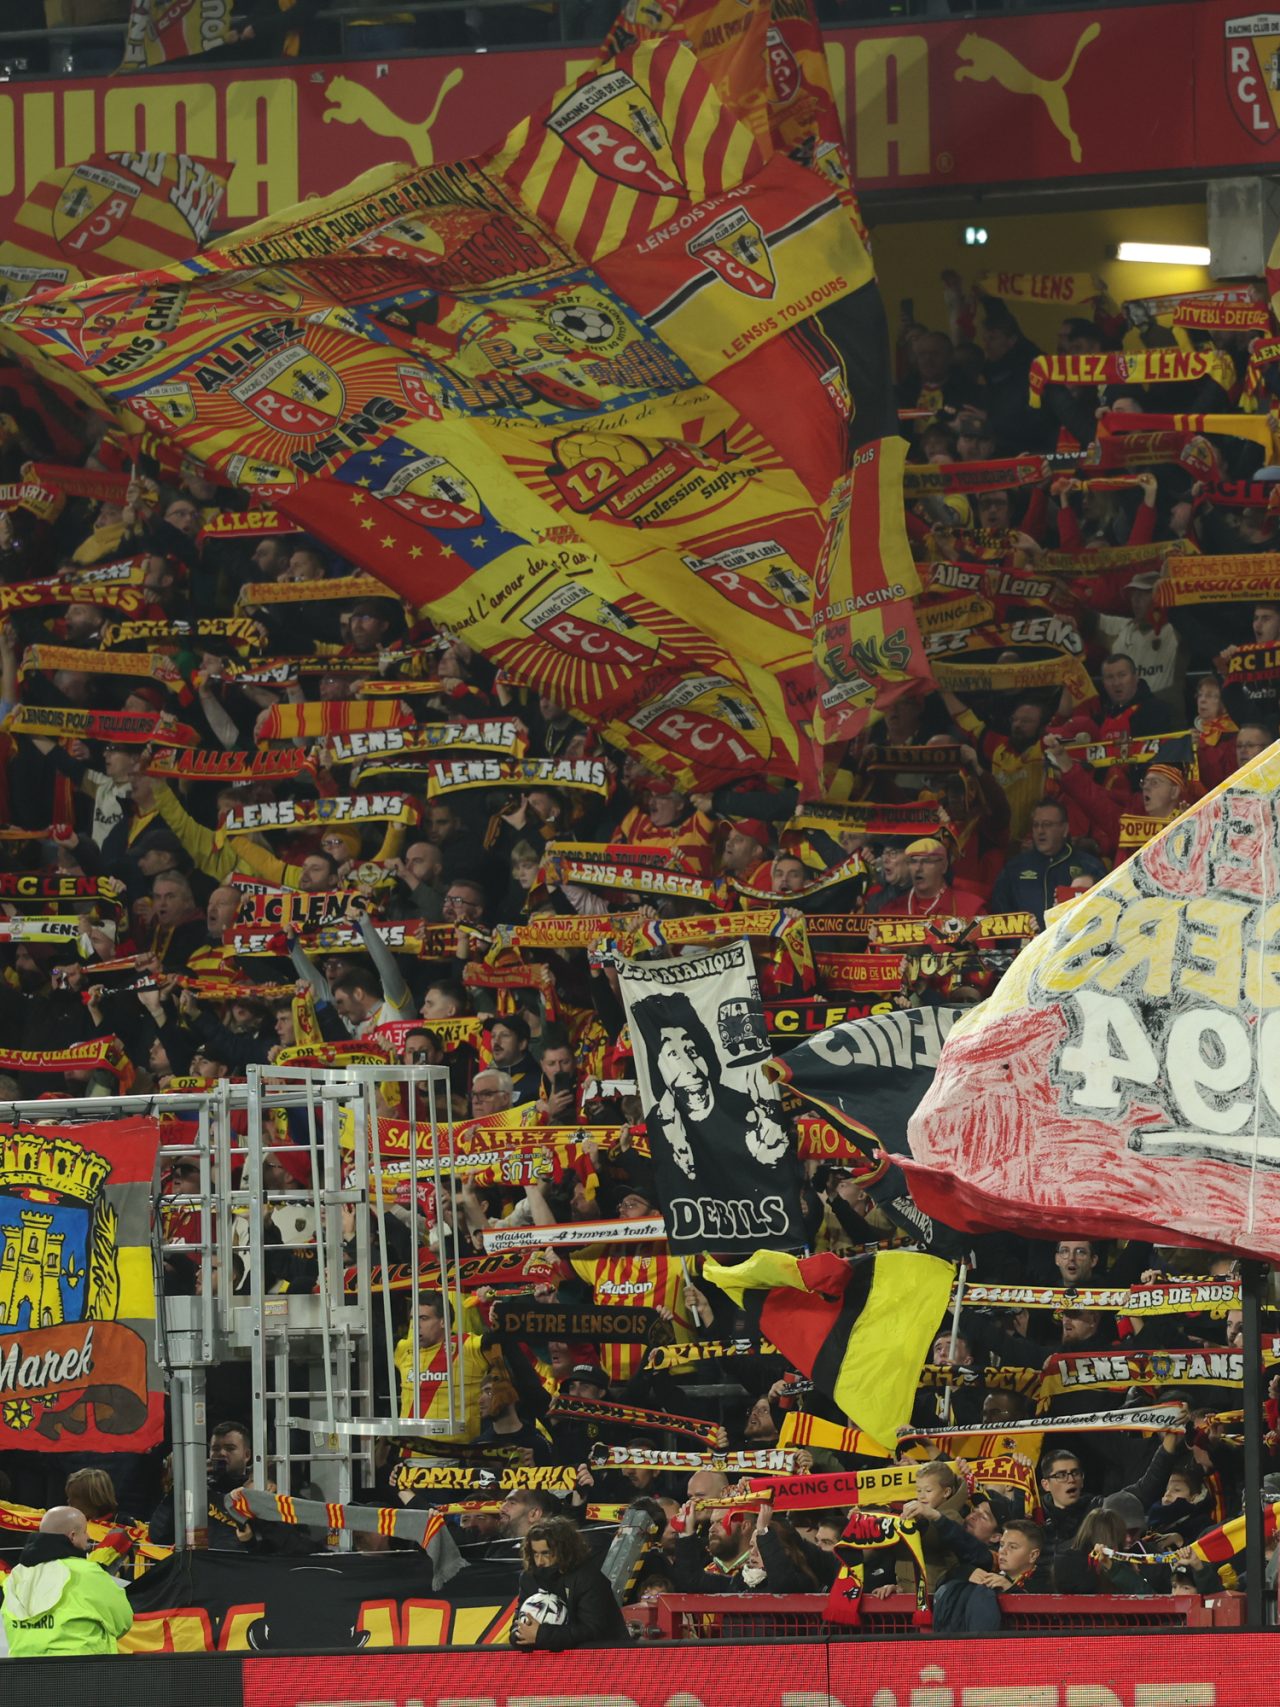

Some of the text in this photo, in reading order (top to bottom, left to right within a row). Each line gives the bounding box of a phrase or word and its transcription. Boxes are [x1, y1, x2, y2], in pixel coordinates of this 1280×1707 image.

[1228, 24, 1252, 35] RACING
[1253, 23, 1270, 33] CLUB
[1271, 22, 1279, 31] DE
[555, 76, 632, 129] RACING CLUB DE LENS
[1231, 46, 1270, 130] RCL
[0, 78, 299, 220] UMA
[576, 124, 676, 192] RCL
[703, 248, 766, 294] RCL
[998, 272, 1075, 300] RC LENS
[193, 319, 307, 395] ALLEZ
[1146, 350, 1208, 382] LENS
[253, 394, 329, 427] RCL
[567, 466, 622, 506] 12
[610, 463, 677, 513] Lensois
[50, 580, 139, 612] LENS
[933, 561, 1052, 599] Allez Lens
[532, 592, 585, 627] RACING CLUB
[549, 619, 646, 664] RCL
[1228, 654, 1257, 679] RC
[332, 721, 517, 760] LENS FANS
[657, 712, 757, 764] RCL
[178, 748, 306, 776] ALLEZ LENS
[433, 757, 607, 788] LENS FANS
[226, 797, 406, 830] LENS FANS
[570, 864, 619, 887] LENS
[640, 875, 705, 901] BASTA
[711, 914, 777, 938] LENS
[841, 965, 868, 981] CLUB
[296, 1043, 316, 1058] OR
[176, 1077, 199, 1089] OR
[598, 1279, 653, 1297] Auchan
[1166, 1279, 1231, 1304] DE NOS
[504, 1308, 648, 1336] D'ÊTRE LENSOIS
[1064, 1353, 1242, 1388] LENS FANS
[612, 1446, 704, 1467] DEVILS
[769, 1473, 903, 1499] RACING CLUB DE
